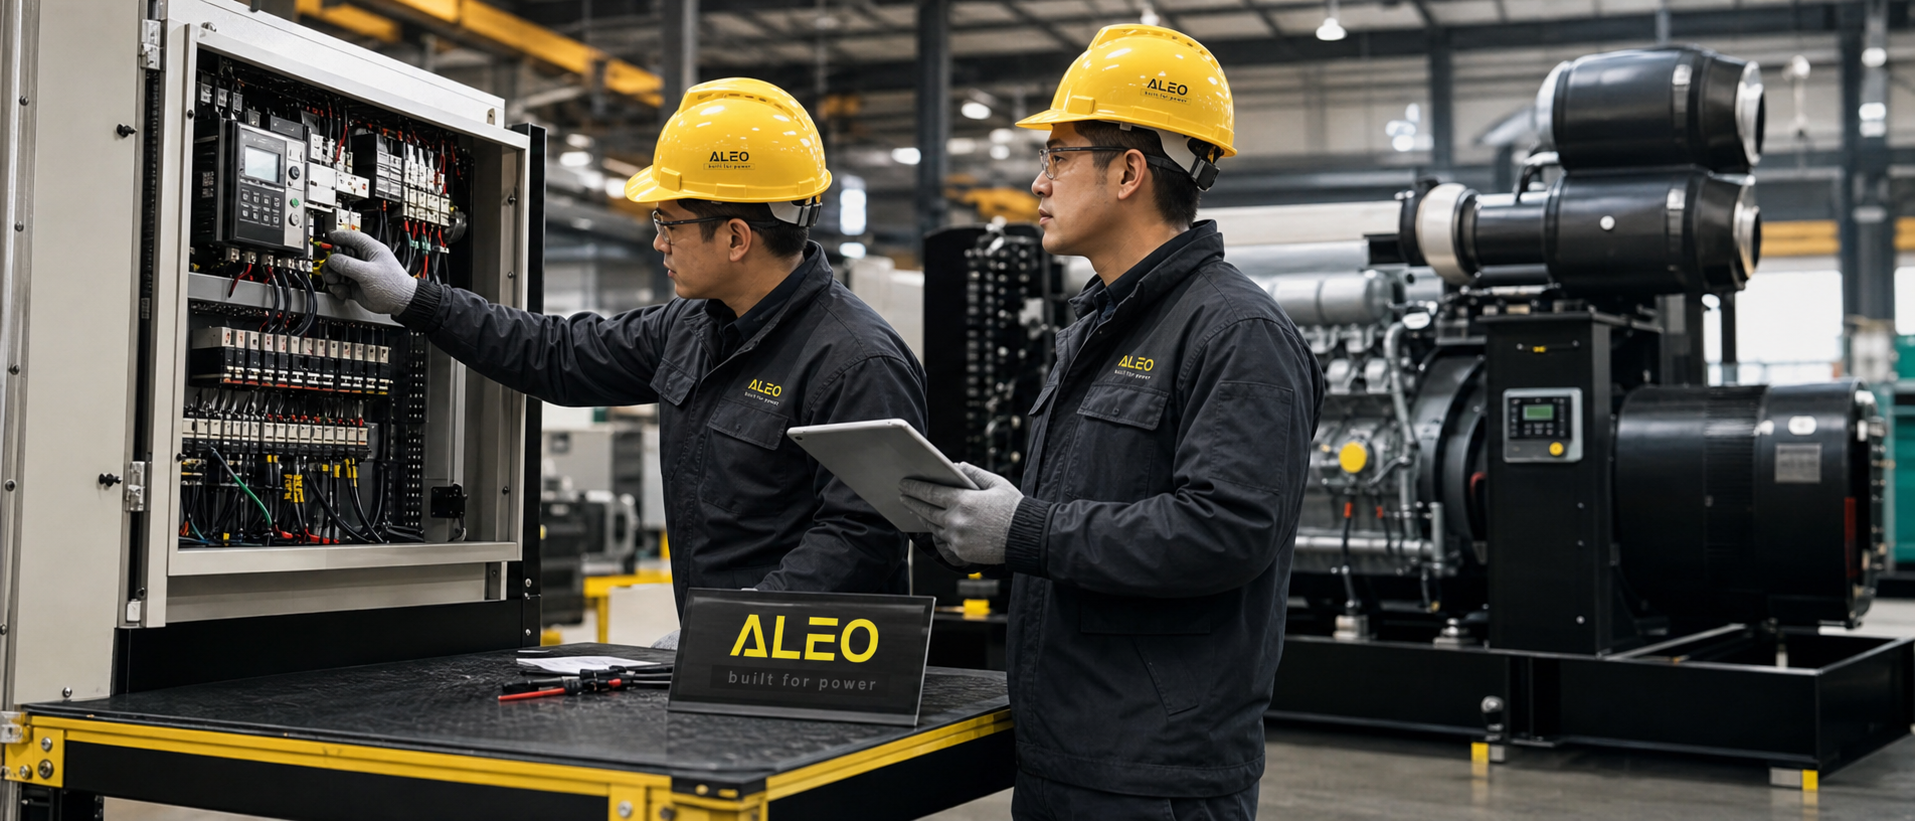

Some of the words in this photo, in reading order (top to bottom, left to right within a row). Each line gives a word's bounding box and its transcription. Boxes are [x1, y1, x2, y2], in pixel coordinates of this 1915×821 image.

[1147, 78, 1188, 96] ALEO
[709, 151, 749, 162] ALEO
[1117, 354, 1154, 372] ALEO
[747, 378, 782, 398] ALEO
[729, 614, 879, 663] ALEO
[728, 671, 774, 686] built
[782, 673, 810, 688] for
[818, 676, 876, 691] power
